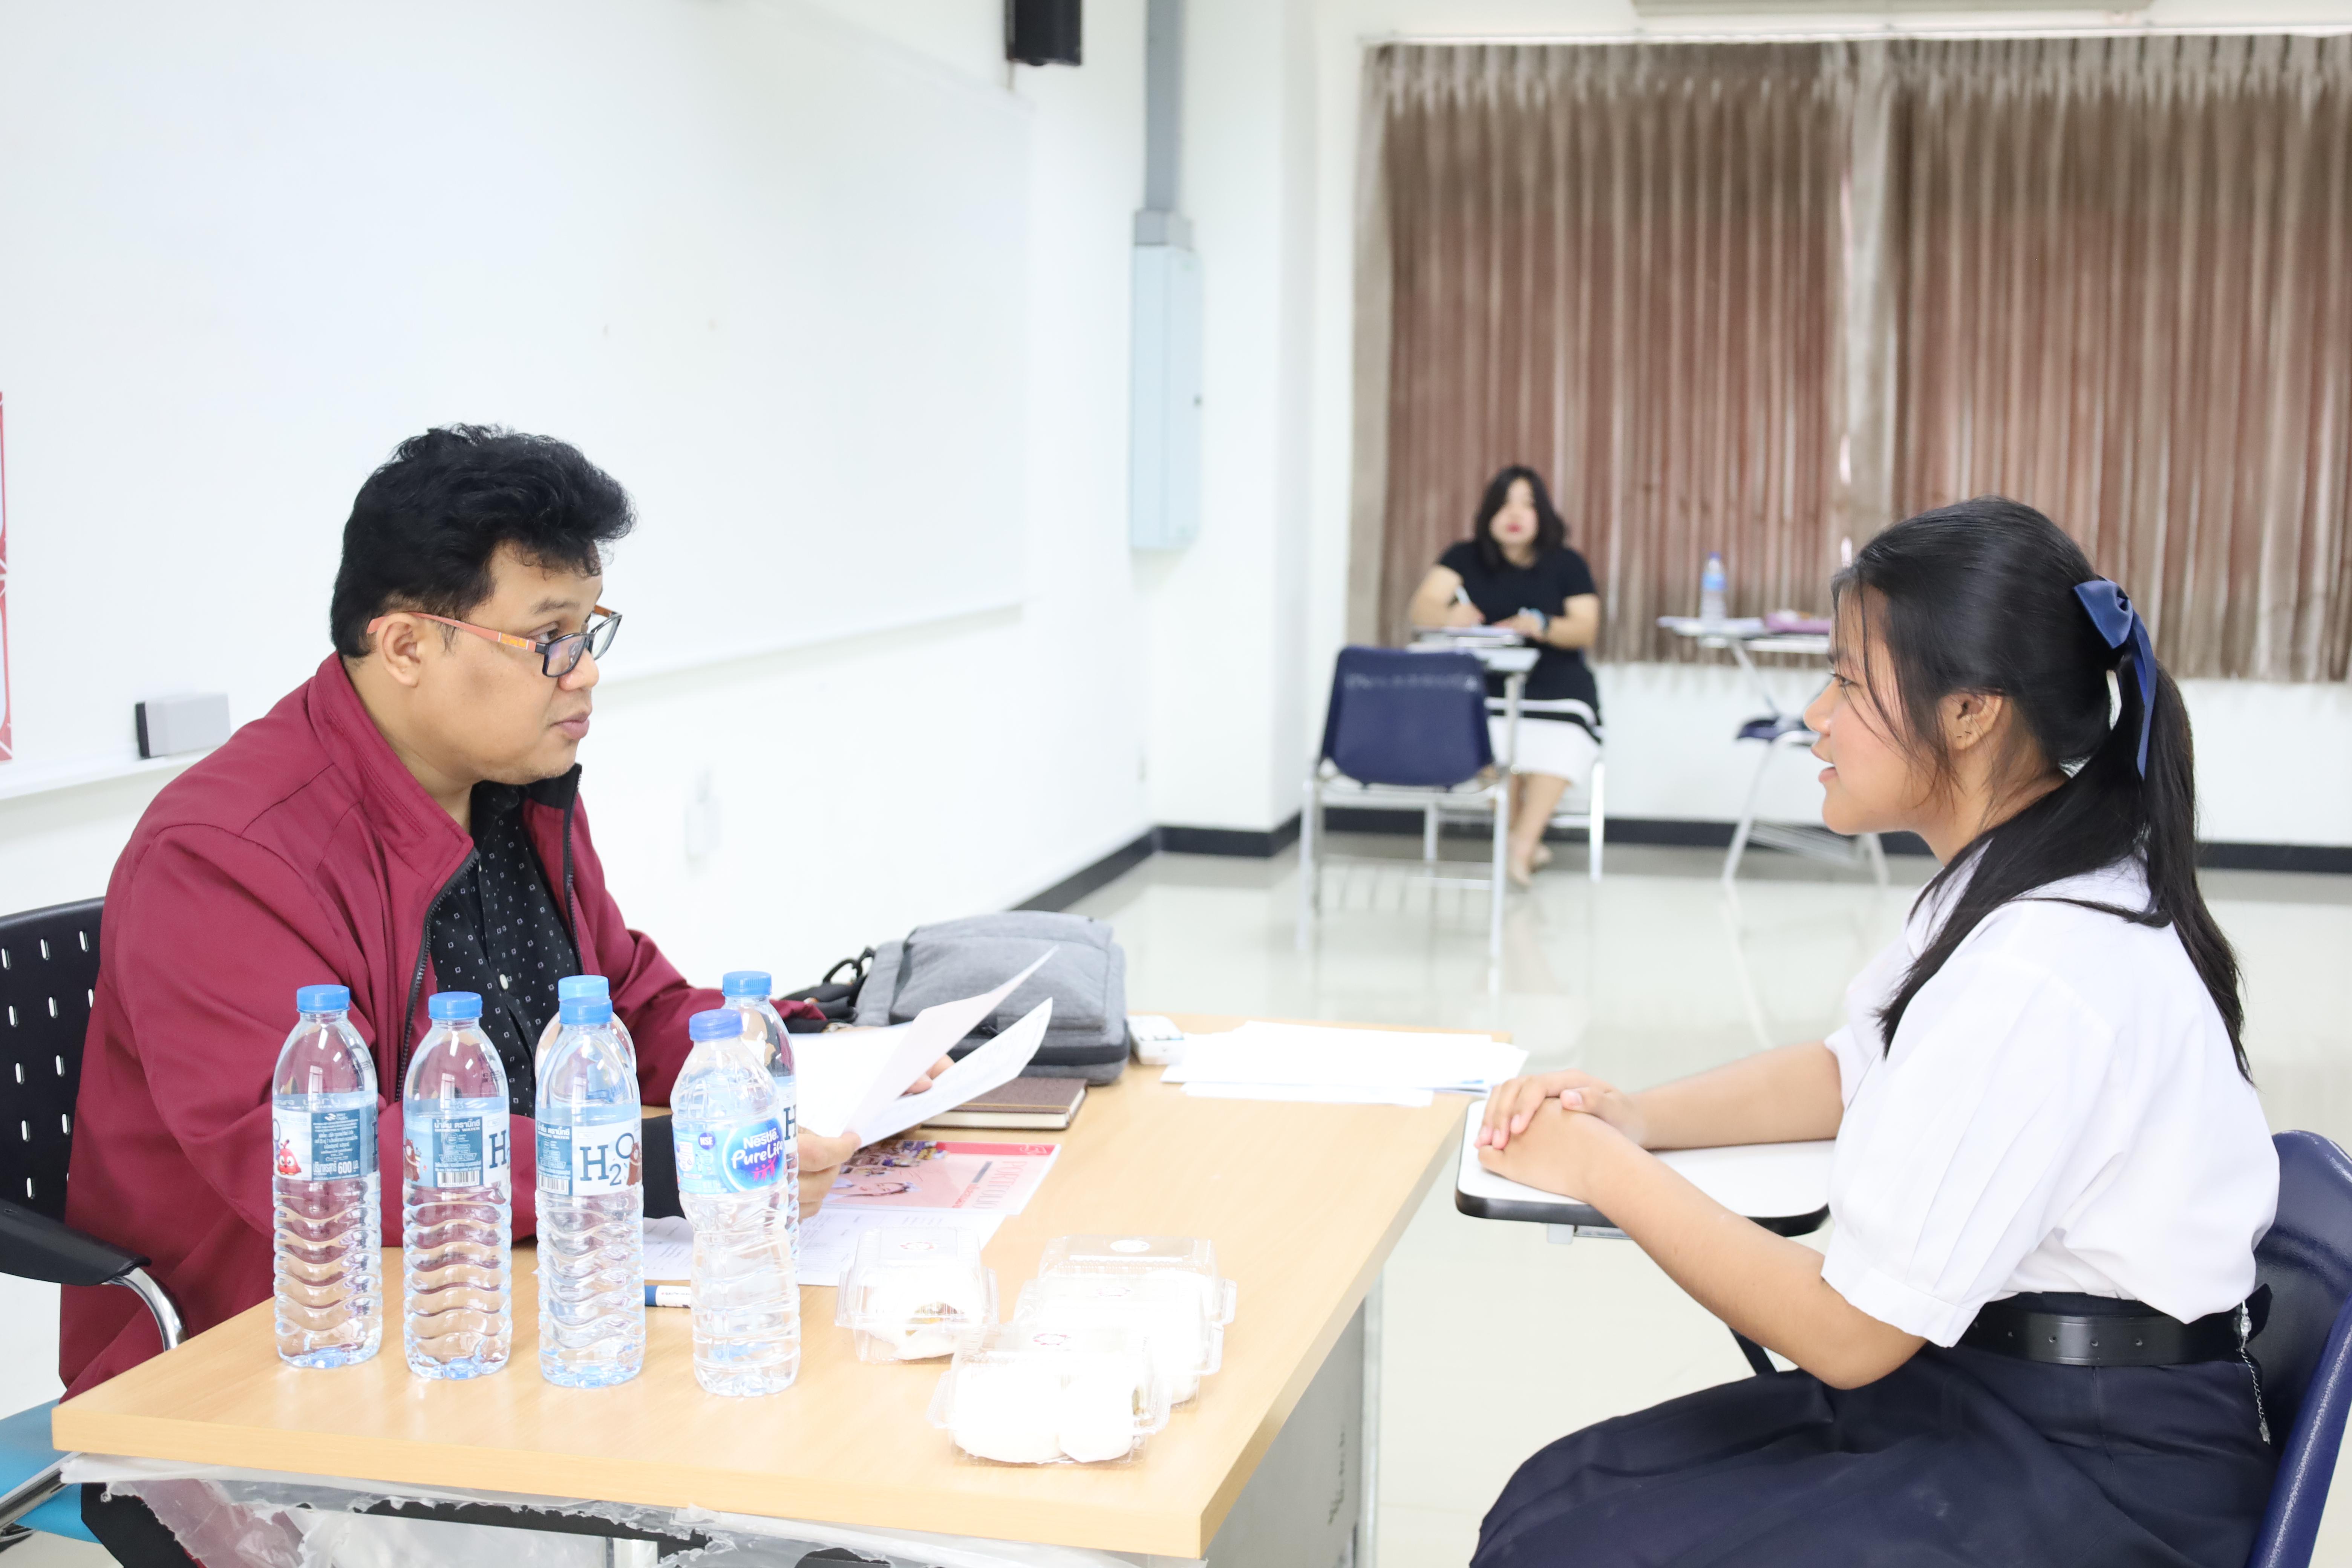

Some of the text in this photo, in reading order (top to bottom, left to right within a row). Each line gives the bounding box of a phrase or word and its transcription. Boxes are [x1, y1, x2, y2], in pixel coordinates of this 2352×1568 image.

[743, 1127, 778, 1150] Nestlé
[338, 1161, 352, 1174] 600
[972, 1161, 1028, 1208] PORTFOLIO
